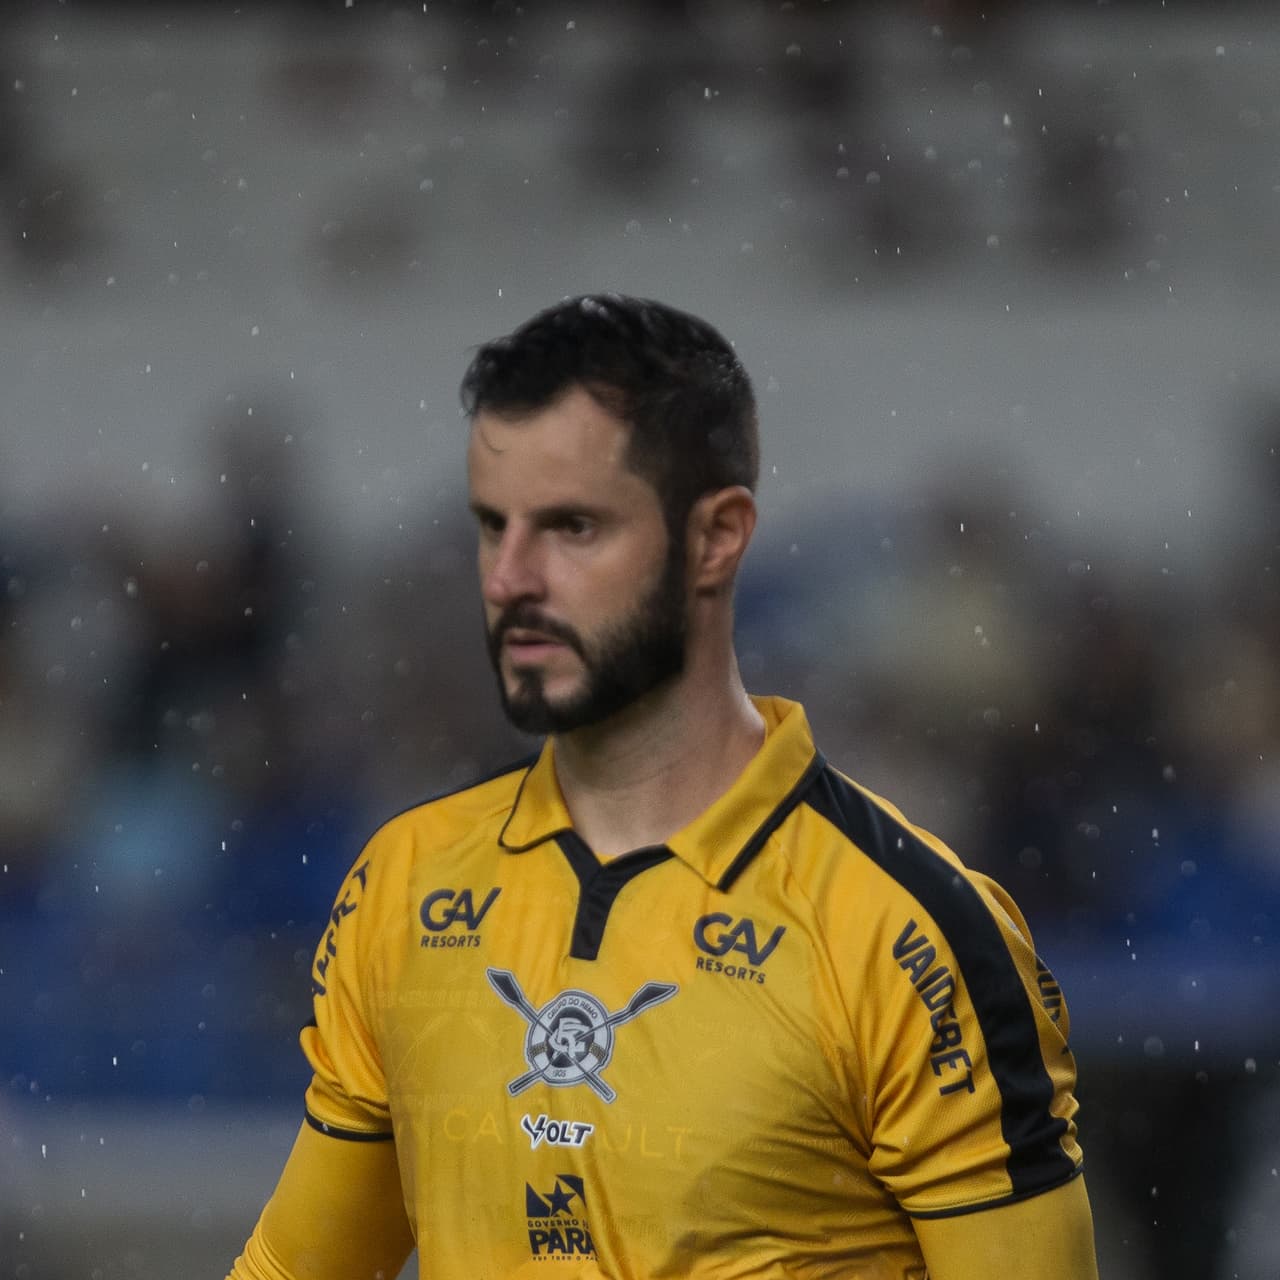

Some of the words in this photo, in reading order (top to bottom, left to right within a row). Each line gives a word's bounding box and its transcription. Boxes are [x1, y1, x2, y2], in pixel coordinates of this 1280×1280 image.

[420, 887, 501, 932] GAV
[421, 935, 480, 948] RESORTS
[693, 912, 786, 966] GAV
[696, 956, 766, 984] RESORTS
[893, 918, 976, 1096] VAIDEBET
[521, 1113, 594, 1151] VOLT
[528, 1218, 579, 1228] GOVERNO
